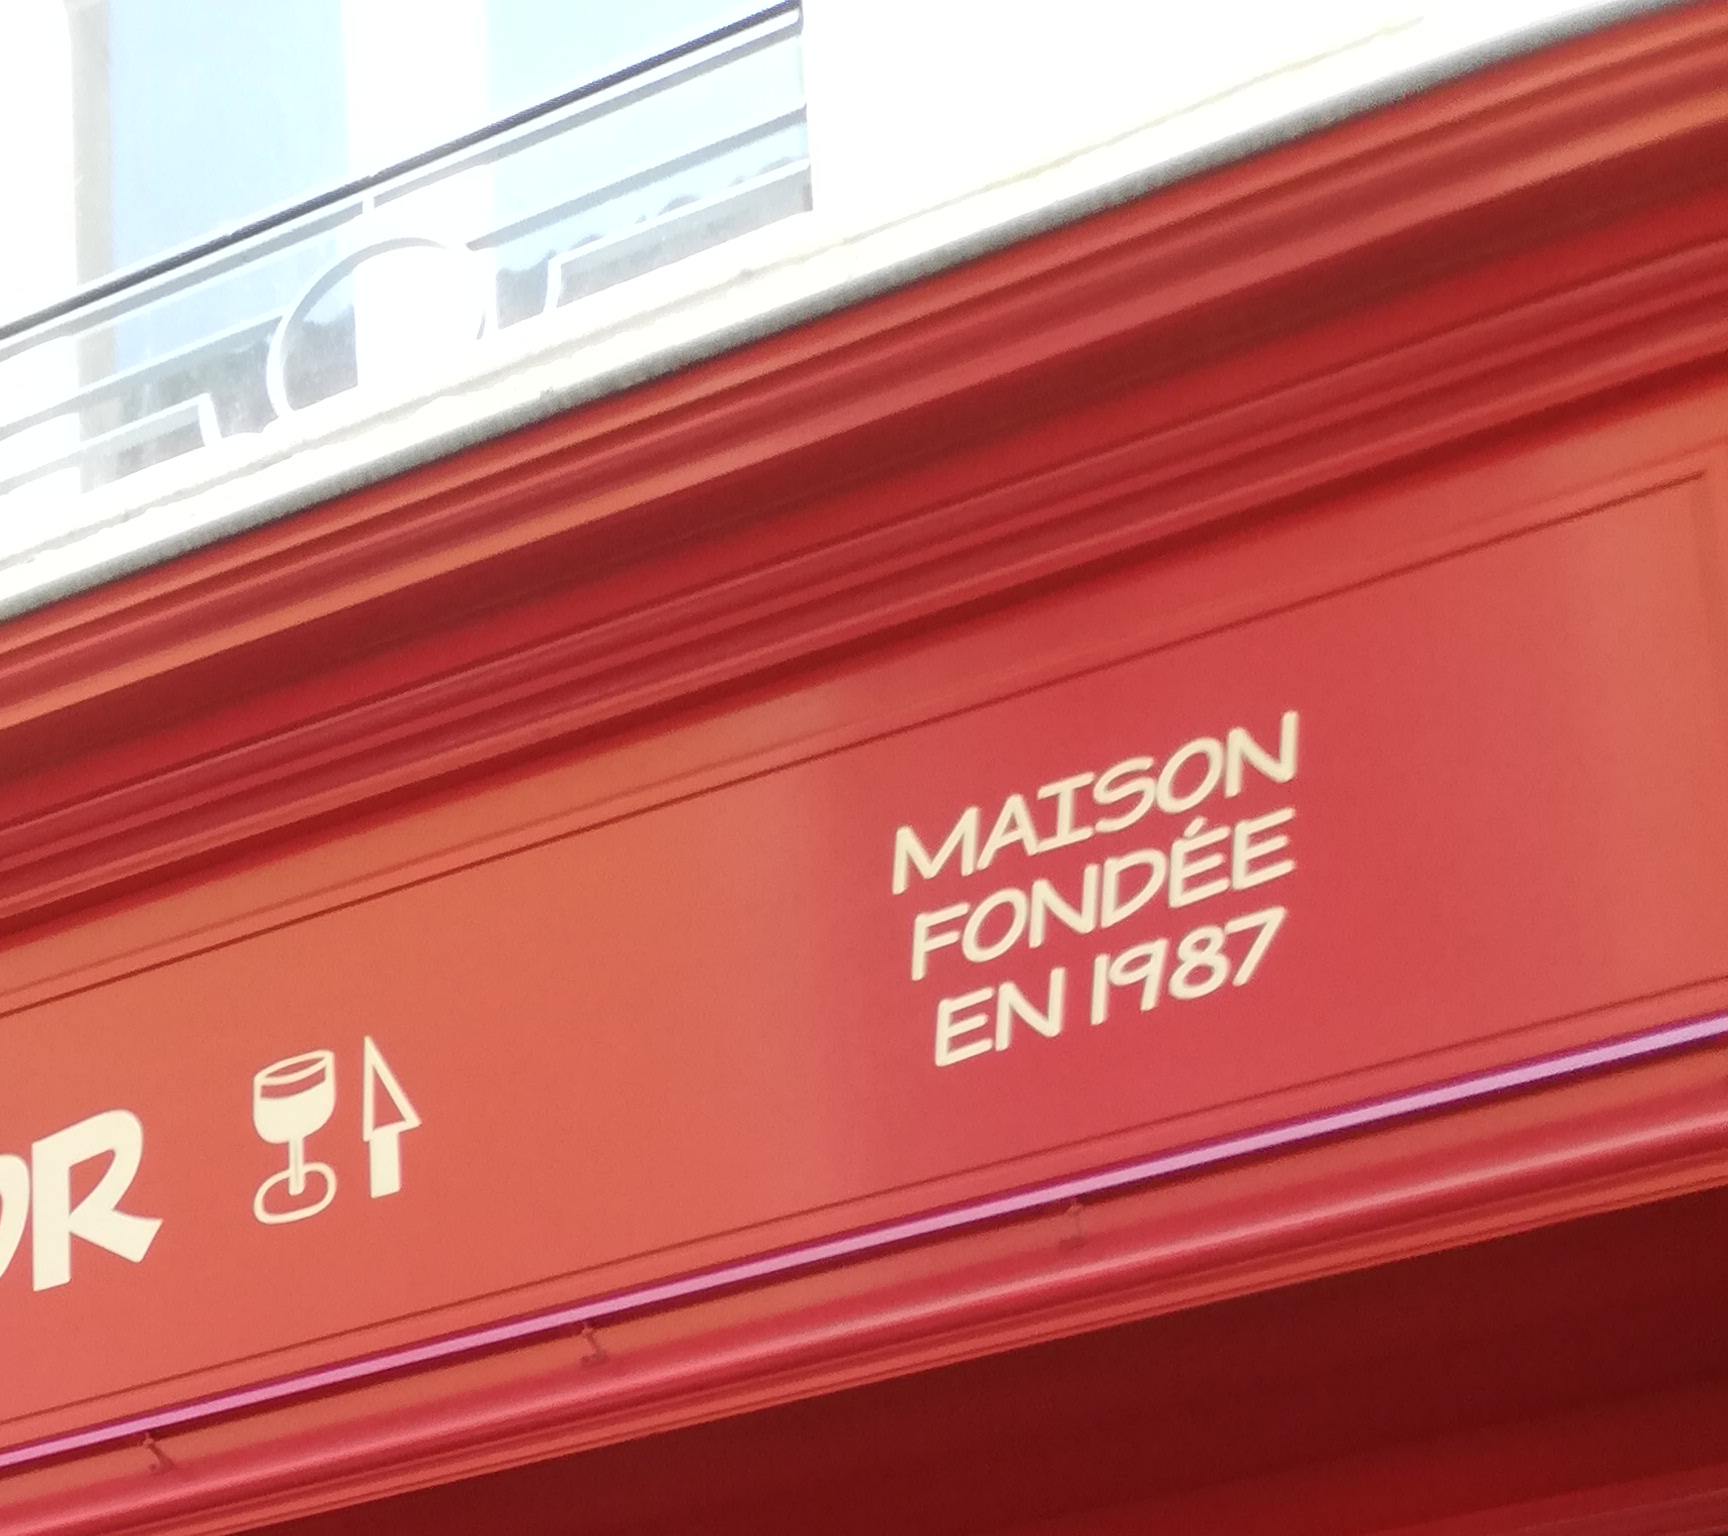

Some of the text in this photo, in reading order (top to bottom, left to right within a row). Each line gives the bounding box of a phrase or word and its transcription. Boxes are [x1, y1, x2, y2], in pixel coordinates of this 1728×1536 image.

[892, 709, 1299, 895] MAISON
[911, 807, 1296, 981] FONDÉE
[934, 906, 1286, 1067] EN 1987
